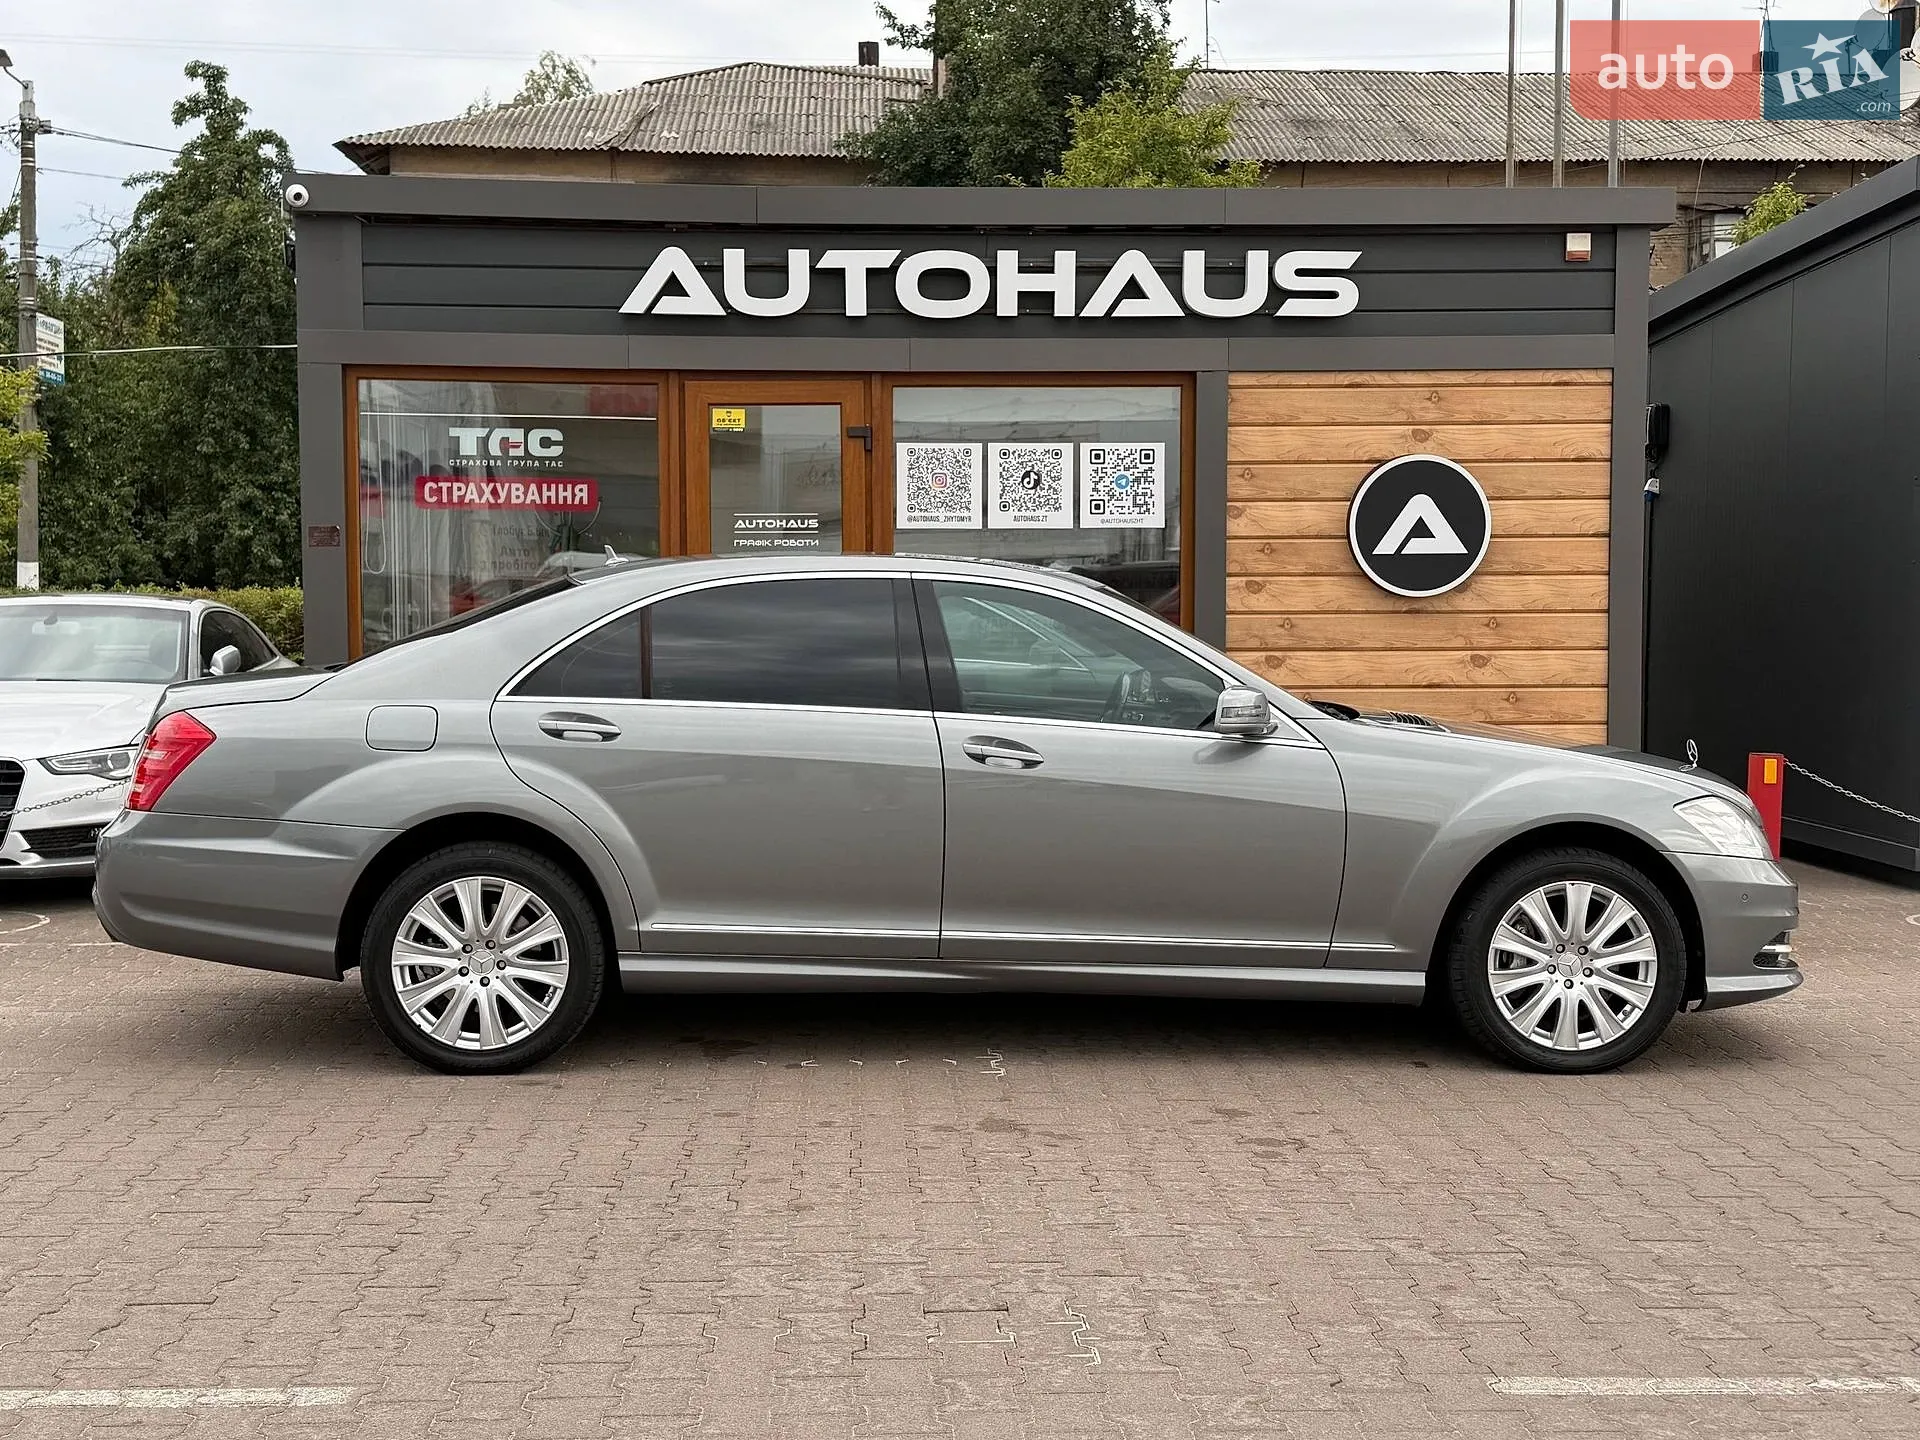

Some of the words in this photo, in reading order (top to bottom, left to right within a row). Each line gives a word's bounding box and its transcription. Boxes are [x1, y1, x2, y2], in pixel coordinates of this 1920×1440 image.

[618, 246, 1362, 318] AUTOHAUS
[449, 427, 564, 457] ТАС
[449, 459, 502, 467] СТРАХОВА
[507, 459, 540, 467] ГРУПА
[544, 460, 564, 468] ТАС
[424, 481, 588, 505] СТРАХУВАННЯ
[734, 519, 819, 528] AUTOHAUS
[907, 515, 972, 523] @AUTOHAUS_ZHYTOMYR
